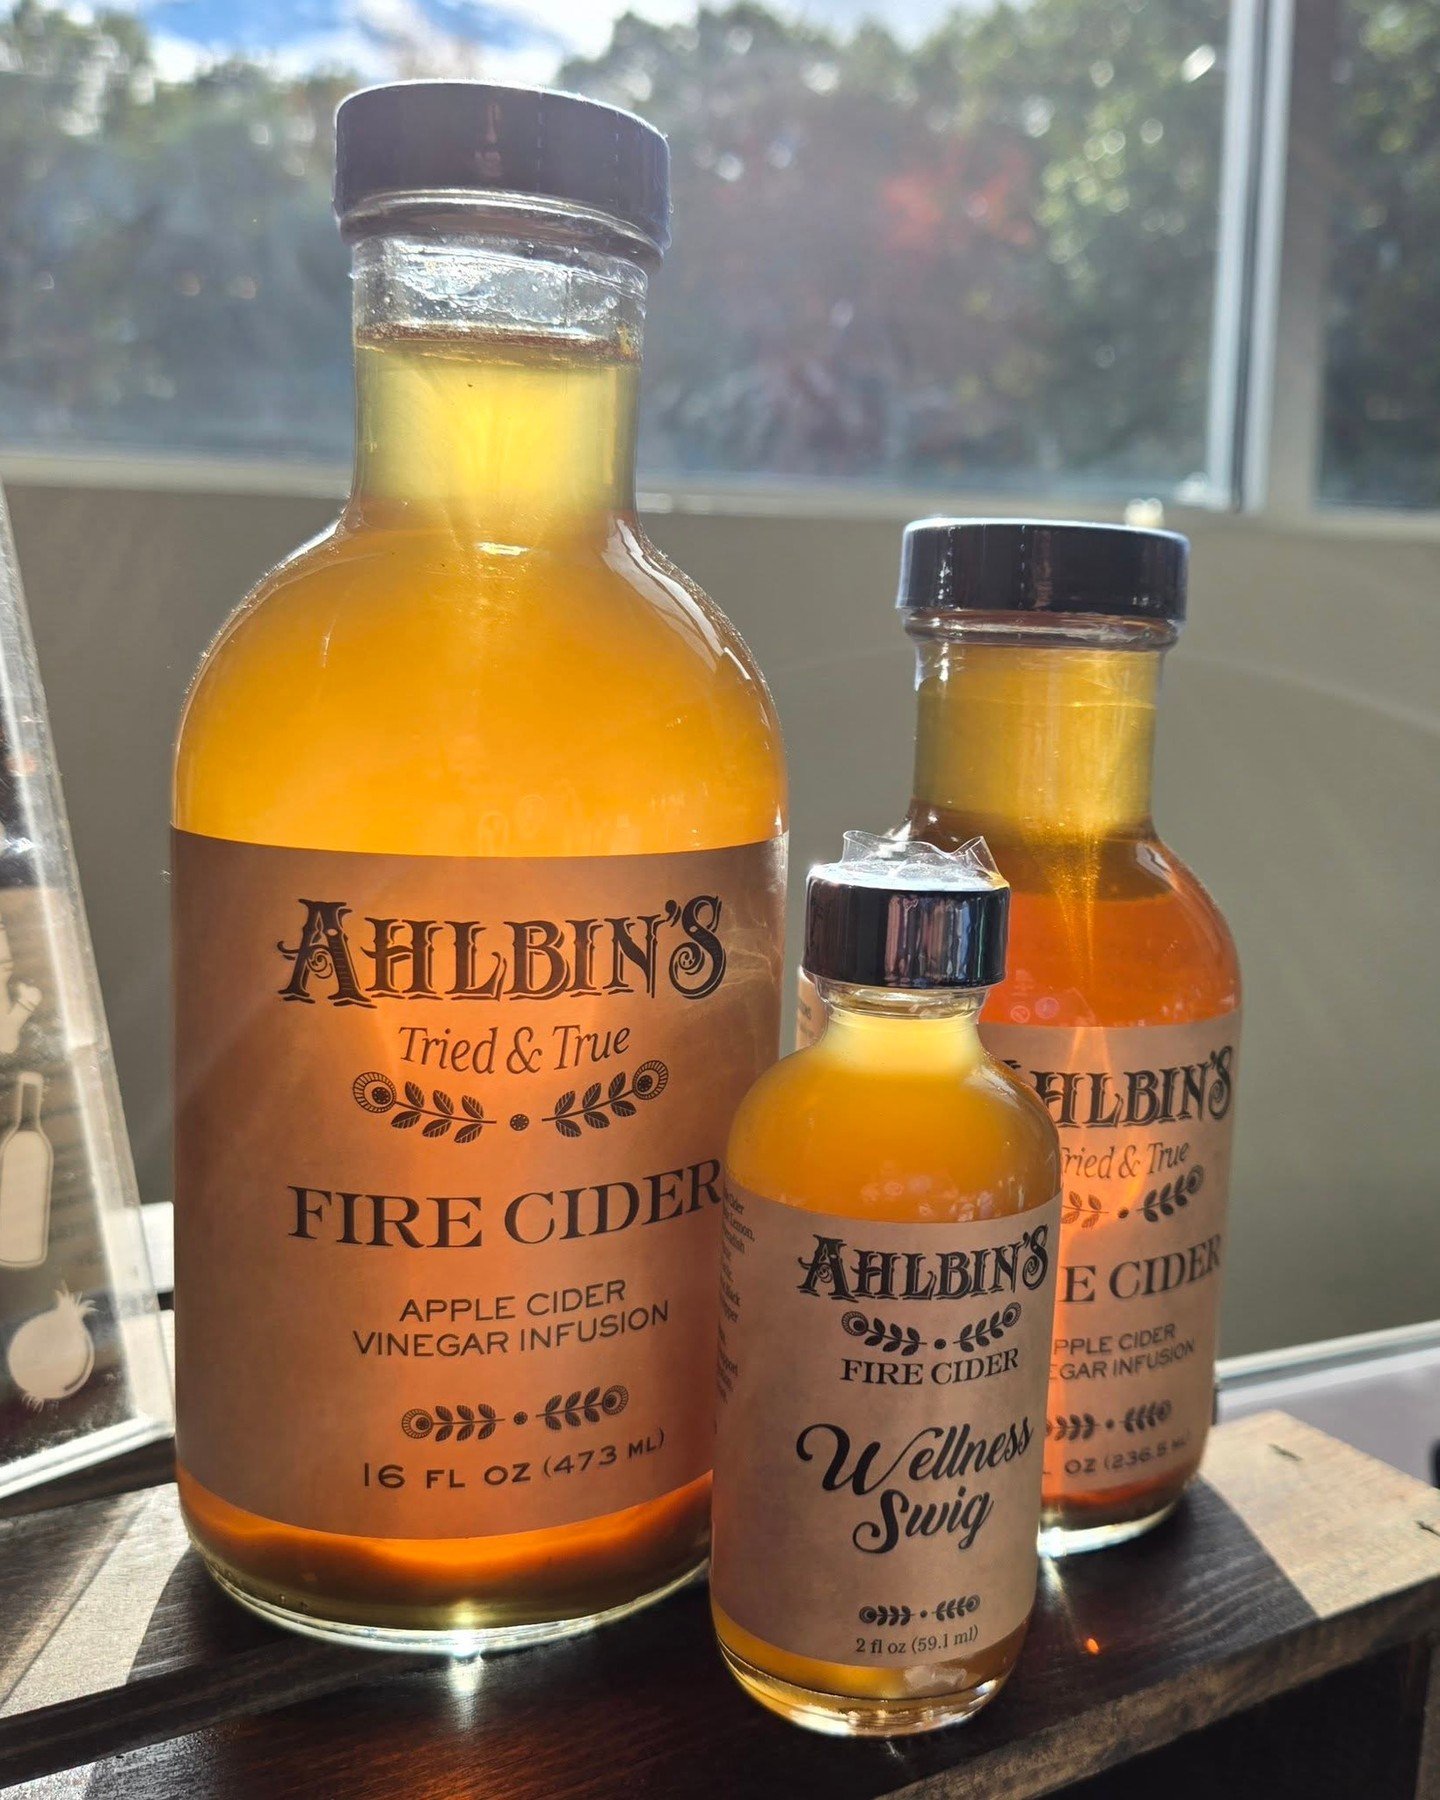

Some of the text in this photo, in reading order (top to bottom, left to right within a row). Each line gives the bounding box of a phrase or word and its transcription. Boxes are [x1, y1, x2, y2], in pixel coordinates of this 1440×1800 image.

[277, 895, 727, 1009] AHLBIN'S
[399, 1024, 631, 1074] Tried & True
[1003, 1045, 1233, 1128] HLBIN'S
[1118, 1145, 1140, 1178] &
[1147, 1142, 1189, 1175] True
[287, 1185, 483, 1248] FIRE
[504, 1158, 722, 1246] CIDER
[797, 1224, 1048, 1302] AHLBIN'S
[1109, 1233, 1221, 1299] CIDER
[353, 1300, 668, 1357] VINEGAR INFUSION
[399, 1279, 626, 1322] APPLE CIDER
[840, 1348, 1019, 1386] FIRE CIDER
[1053, 1323, 1176, 1355] PPLE CIDER
[1113, 1337, 1195, 1376] INFUSION
[363, 1428, 665, 1489] 16 FL OZ (473 ML)
[796, 1416, 1034, 1496] Wellness
[1064, 1458, 1096, 1475] OZ
[852, 1485, 994, 1554] Swig
[855, 1625, 979, 1656] 2 fl oz (59.1 ml)
